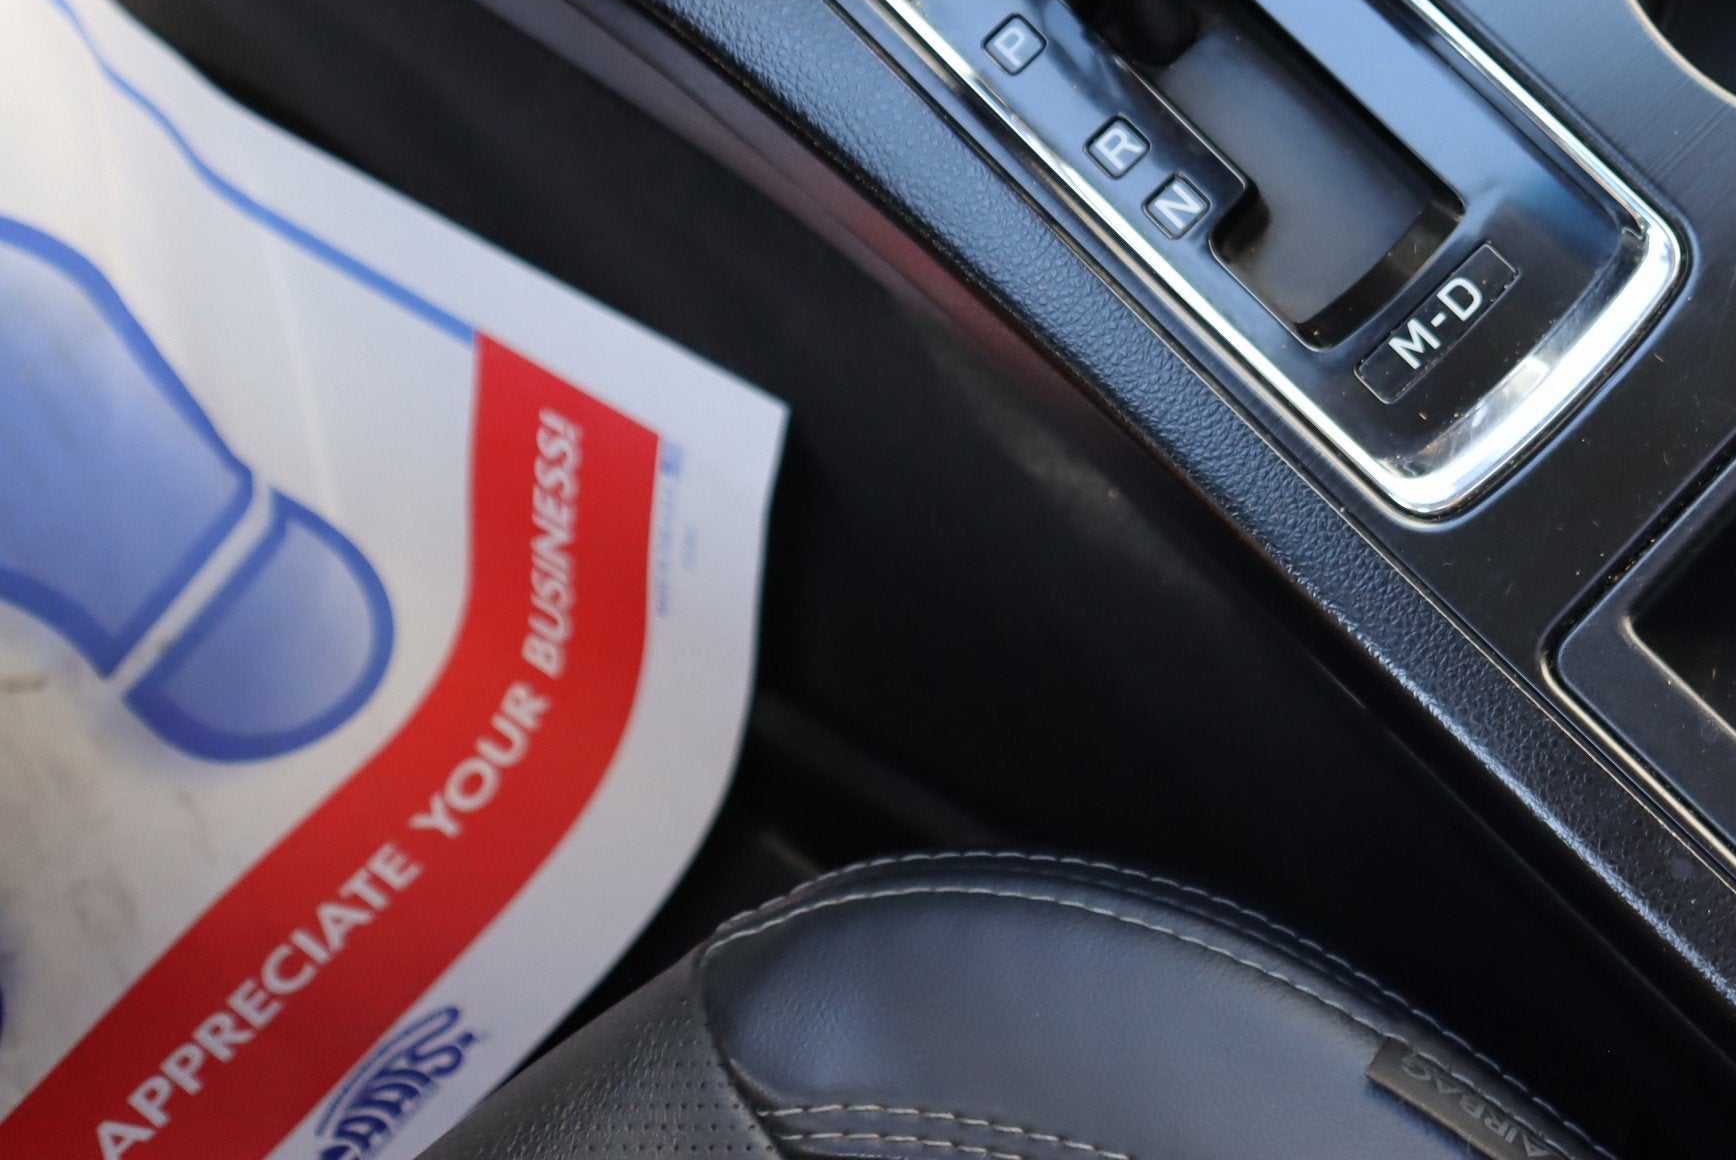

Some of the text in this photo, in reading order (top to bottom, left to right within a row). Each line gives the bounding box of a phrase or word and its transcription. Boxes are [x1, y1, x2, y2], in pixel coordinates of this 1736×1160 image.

[993, 26, 1025, 67] P
[1095, 127, 1145, 170] R
[1154, 183, 1202, 229] N
[1388, 277, 1483, 370] M-D
[96, 407, 586, 1160] APPRECIATE YOUR BUSINESS!
